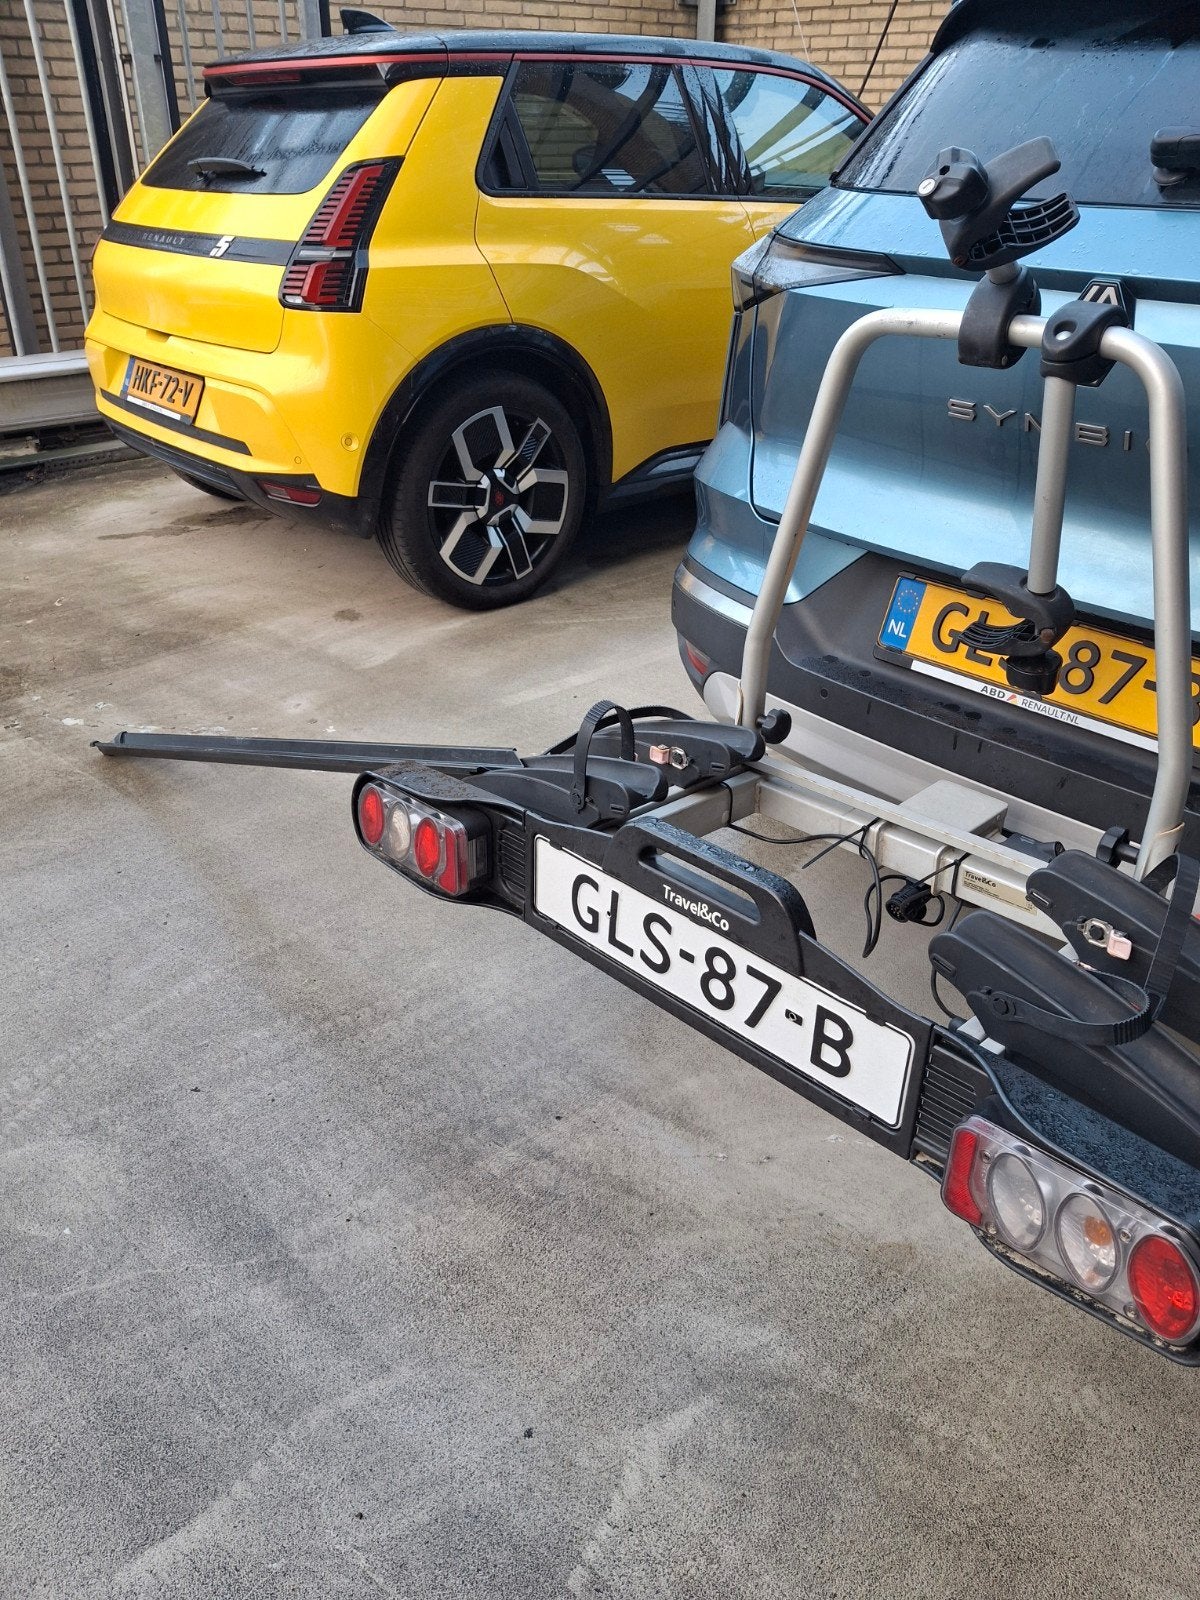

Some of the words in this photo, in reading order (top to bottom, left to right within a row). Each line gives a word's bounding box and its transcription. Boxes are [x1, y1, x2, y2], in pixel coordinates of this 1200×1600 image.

[142, 232, 186, 245] RENAULT
[209, 235, 236, 258] 5
[131, 364, 195, 408] HKF-72-V
[887, 618, 907, 639] NL
[980, 684, 1006, 700] ABD
[1021, 698, 1080, 726] RENAULT.NL
[662, 883, 730, 932] Travel&Co
[571, 873, 855, 1079] GLS-87-B
